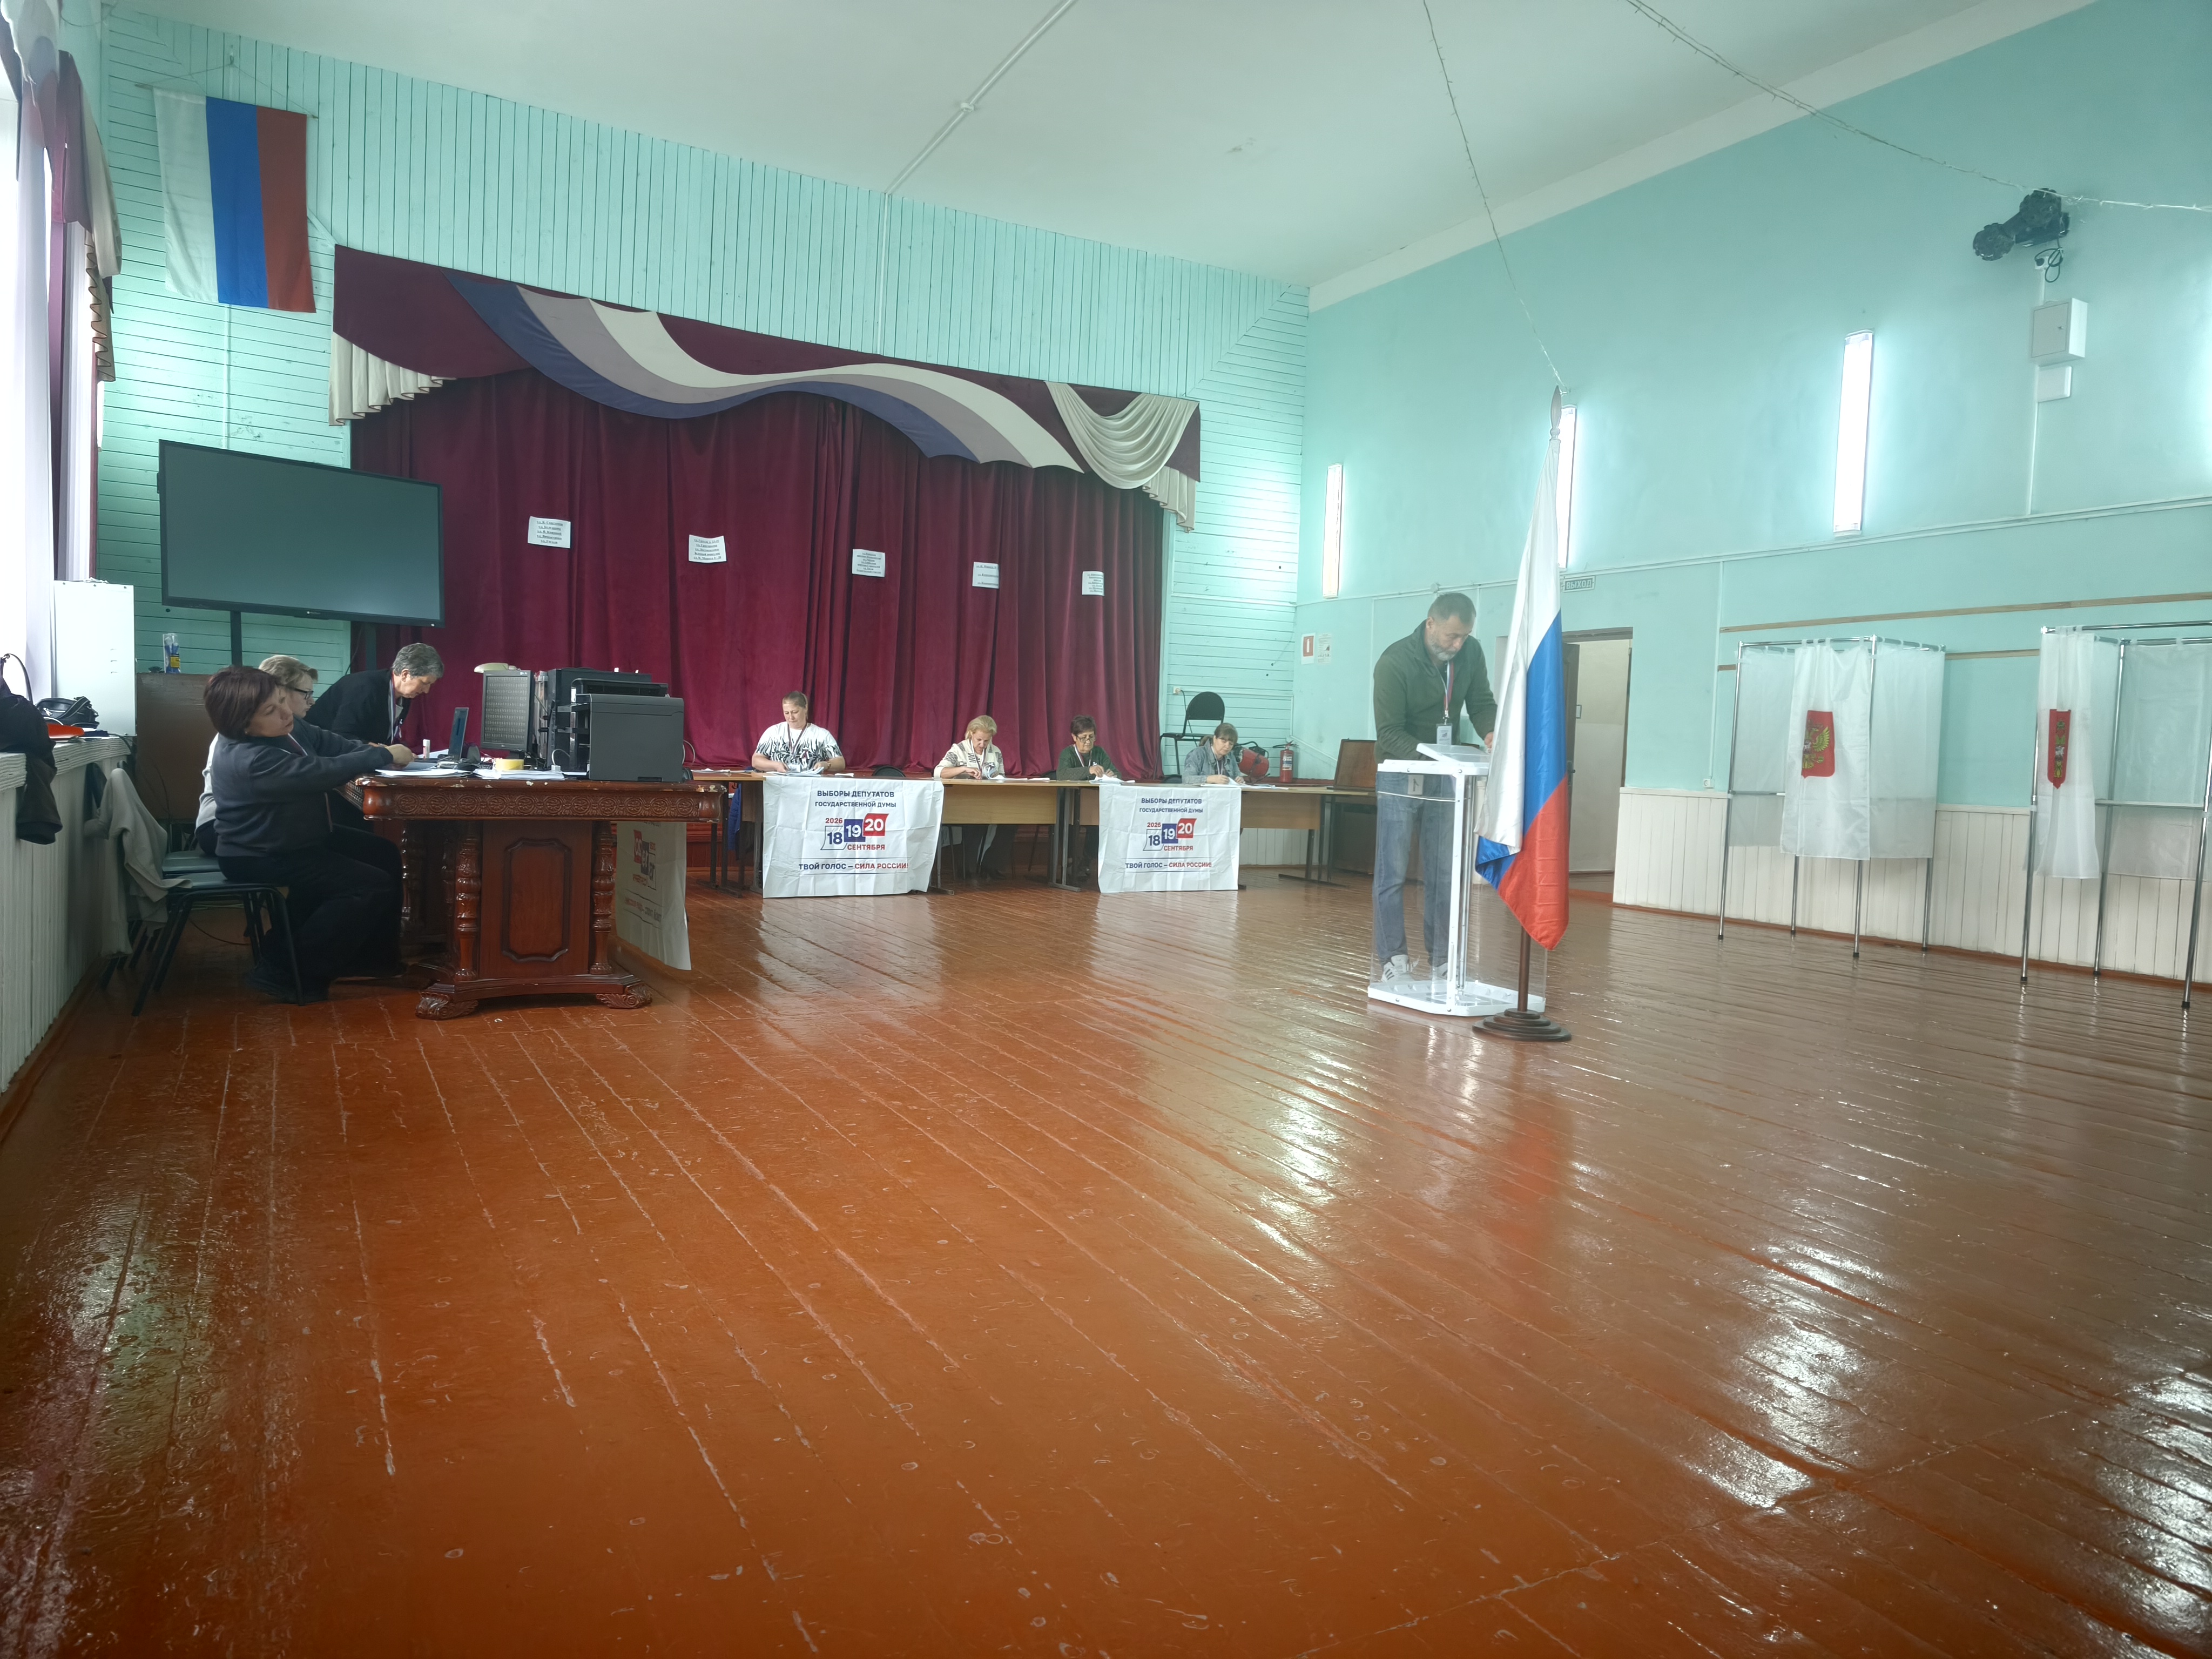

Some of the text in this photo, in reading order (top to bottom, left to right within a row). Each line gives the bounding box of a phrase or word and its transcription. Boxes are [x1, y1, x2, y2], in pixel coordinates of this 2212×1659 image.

[1566, 579, 1591, 589] ВЫХОД
[827, 818, 884, 845] 18 19 20
[1148, 822, 1193, 846] 18 19 20
